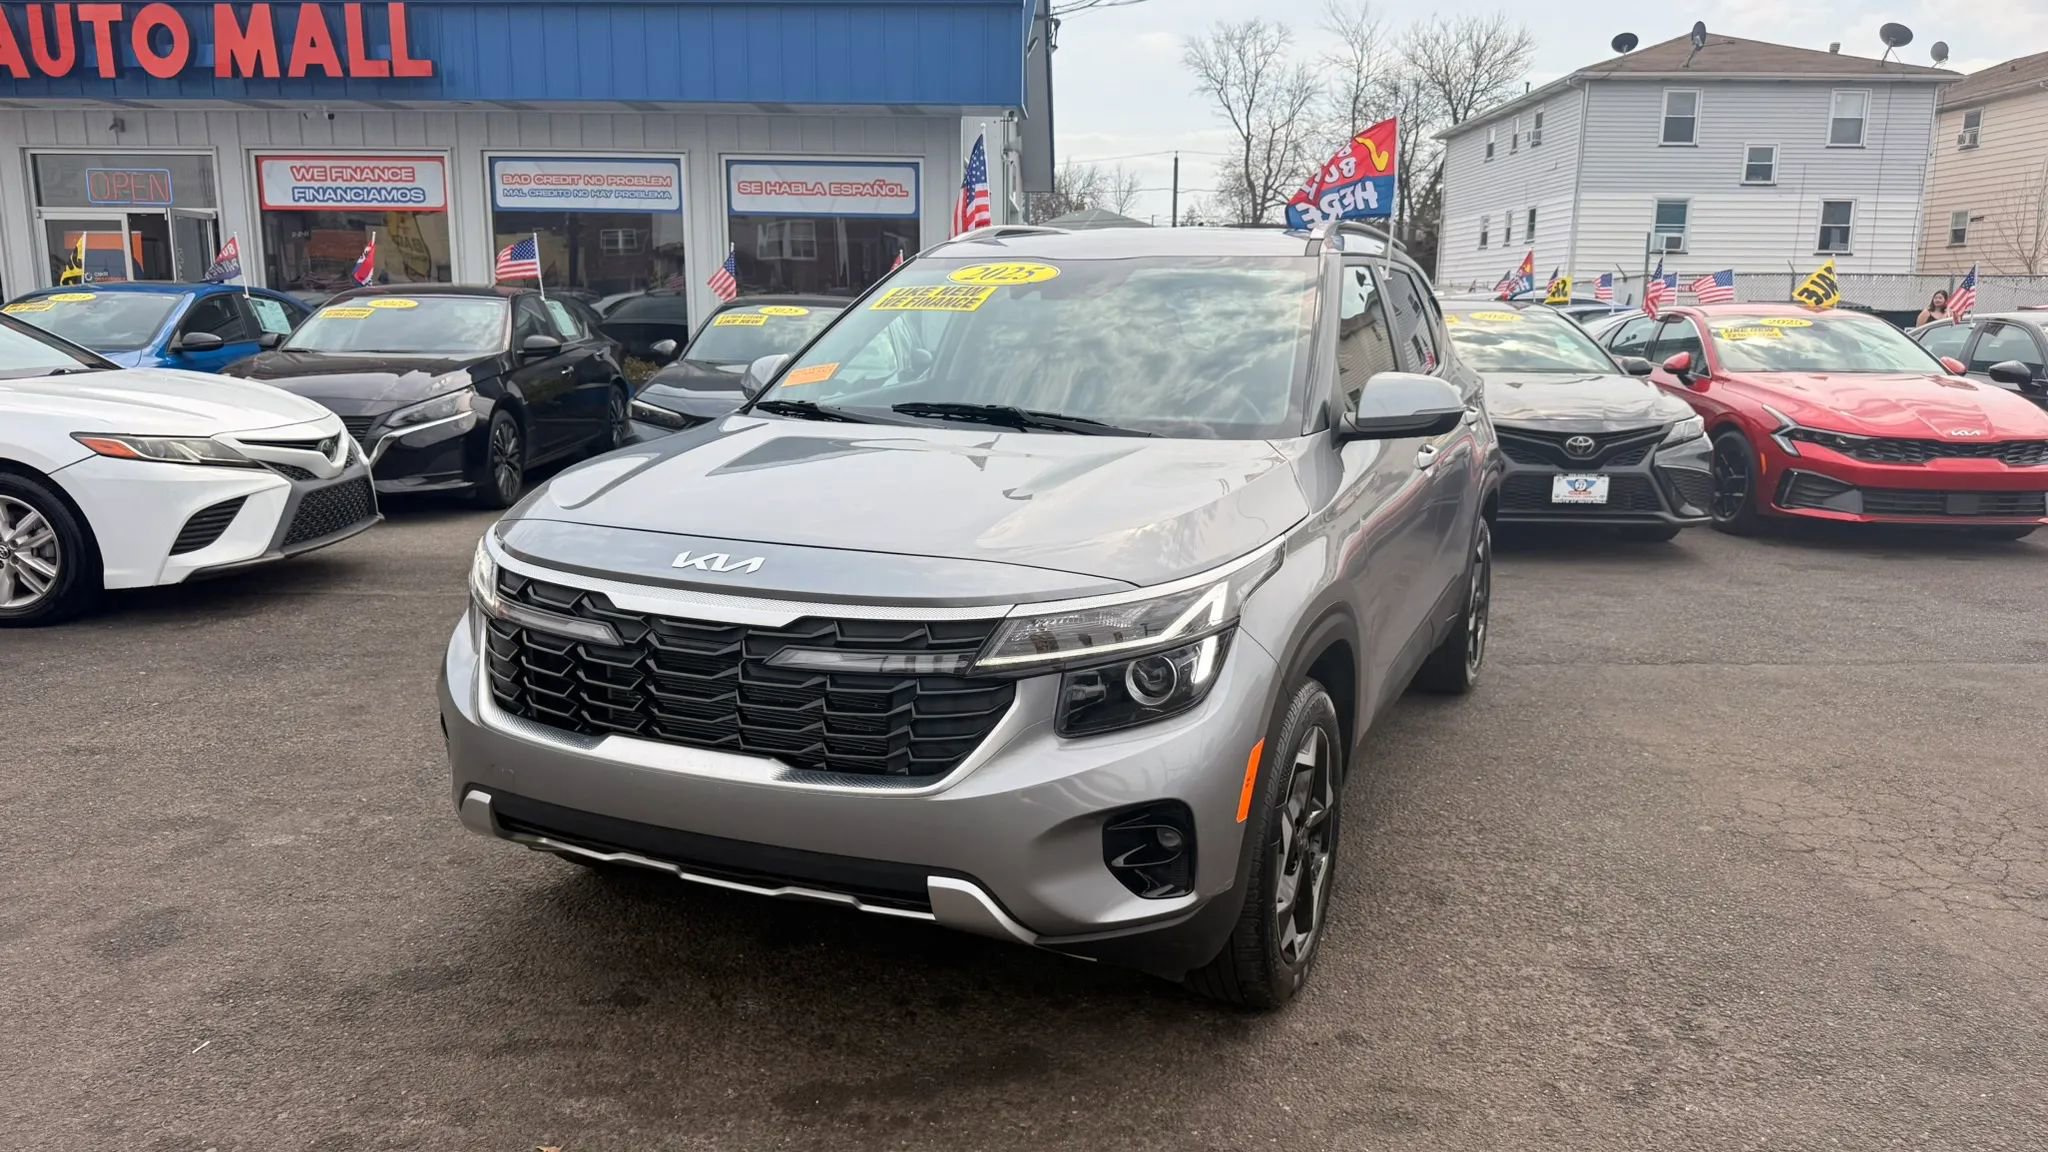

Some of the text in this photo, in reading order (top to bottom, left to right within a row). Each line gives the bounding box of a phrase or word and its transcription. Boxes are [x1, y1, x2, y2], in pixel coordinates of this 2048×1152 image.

[214, 3, 433, 79] MALL
[291, 166, 416, 183] WE FINANCE
[502, 174, 672, 187] BAD CREDIT NO PROBLEM
[90, 172, 169, 202] OPEN
[292, 187, 426, 203] FINANCIAMOS
[503, 188, 672, 200] MAL CREDITO NO HAY PROBLEMA
[737, 178, 909, 197] SE HABLA ESPAÑOL
[962, 265, 1046, 281] 2025
[893, 286, 987, 297] LIKE NEW
[906, 297, 982, 309] FINANCE
[671, 550, 766, 574] KIA
